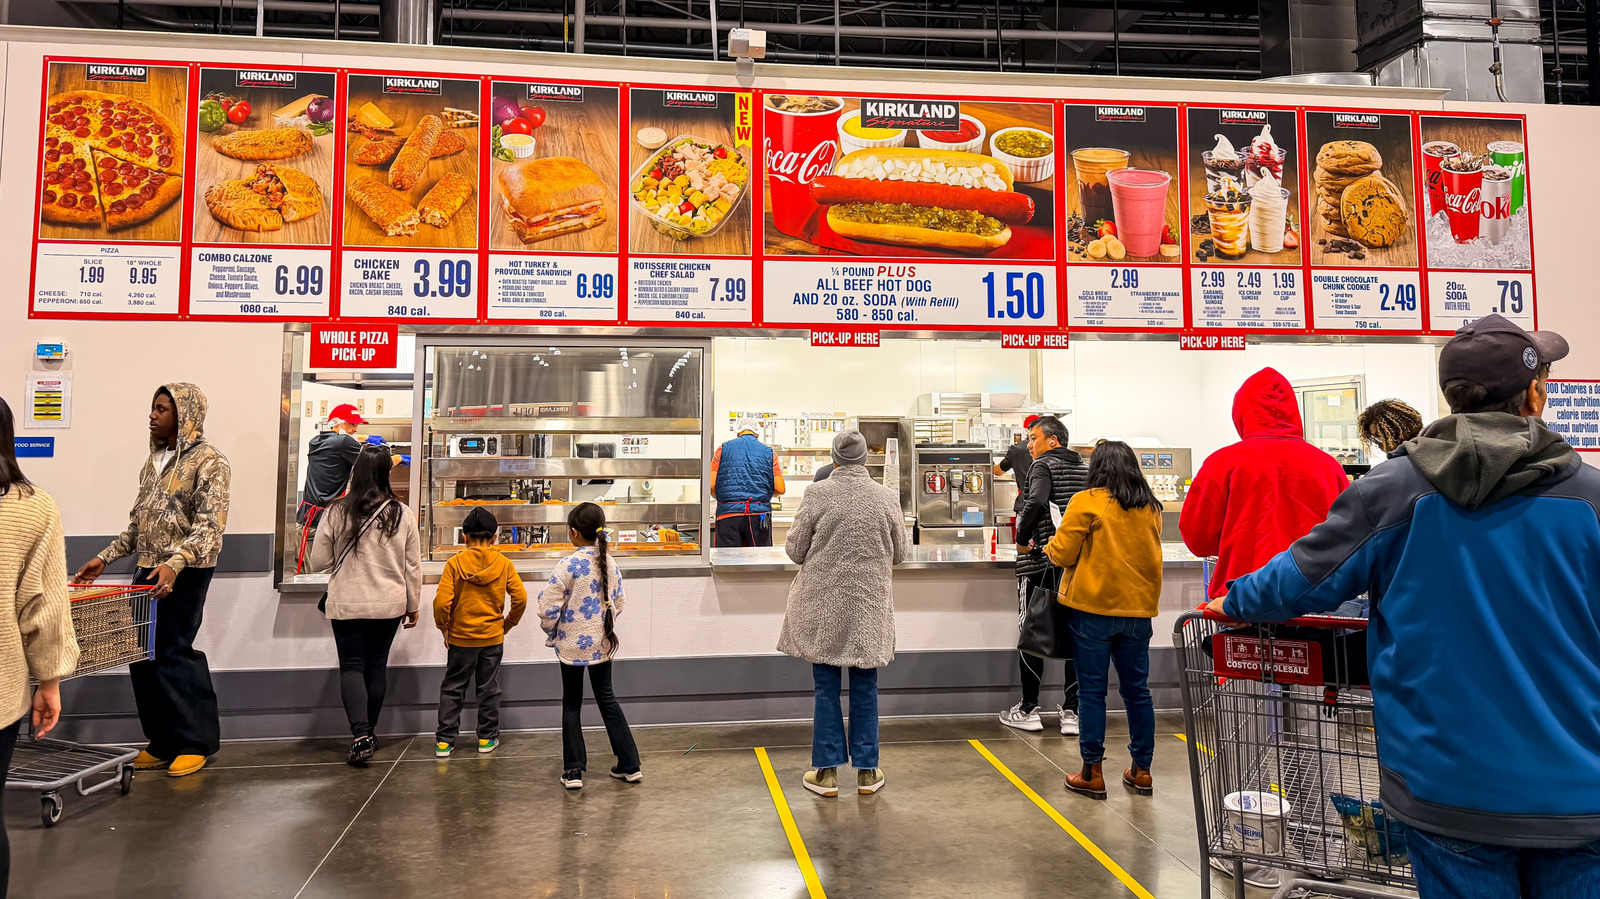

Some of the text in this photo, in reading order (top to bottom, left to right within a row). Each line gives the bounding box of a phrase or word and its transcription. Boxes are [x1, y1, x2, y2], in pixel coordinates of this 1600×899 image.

[89, 65, 146, 76] KIRKLAND
[240, 71, 294, 82] KIRKLAND
[386, 78, 440, 88] KIRKLAND
[530, 85, 581, 95] KIRKLAND
[666, 92, 715, 101] KIRKLAND
[866, 102, 956, 118] KIRKLAND
[1098, 107, 1144, 116] KIRKLAND
[1222, 110, 1266, 119] KIRKLAND
[737, 96, 751, 140] NEW
[866, 116, 956, 129] Signature
[1336, 114, 1379, 123] KIRKLAND
[198, 253, 273, 263] COMBO CALZONE
[236, 265, 257, 274] Sausage,
[354, 258, 400, 270] CHICKEN
[508, 260, 523, 268] HOT
[524, 260, 551, 268] TURKEY
[633, 262, 711, 271] ROTISSERIE CHICKEN
[79, 266, 105, 283] 1.99
[129, 267, 157, 285] 9.95
[362, 270, 391, 281] BAKE
[494, 268, 535, 276] PROVOLONE
[650, 270, 695, 279] CHEF SALAD
[842, 267, 875, 277] POUND
[877, 266, 917, 278] PLUS
[244, 274, 259, 282] Sauce,
[275, 265, 323, 296] 6.99
[413, 259, 472, 298] 3.99
[1110, 268, 1139, 289] 2.99
[1200, 271, 1225, 288] 2.99
[1237, 271, 1261, 288] 2.49
[1272, 272, 1295, 289] 1.99
[1313, 275, 1339, 283] DOUBLE
[576, 273, 614, 299] 6.99
[709, 277, 746, 302] 7.99
[816, 278, 932, 292] ALL BEEF HOT DOG
[982, 271, 1045, 319] 1.50
[1379, 283, 1416, 311] 2.49
[1445, 291, 1468, 301] SODA
[1492, 280, 1523, 314] .79
[38, 297, 79, 305] PEPPERONI:
[792, 293, 960, 310] AND 20 oz. SODA (With Refill)
[1444, 301, 1471, 311] WITH REFILL
[239, 304, 279, 314] 1080 cal.
[387, 305, 431, 316] 840 cal.
[553, 310, 567, 318] cal.
[675, 310, 706, 319] 840 cal.
[836, 308, 918, 322] 580 850 cal.
[1354, 320, 1381, 329] 750 cal.
[320, 331, 389, 345] WHOLE PIZZA
[812, 331, 879, 345] PICK-UP HERE
[1002, 334, 1068, 347] PICK-UP HERE
[1180, 336, 1245, 348] PICK-UP HERE
[331, 347, 376, 361] PICK-UP
[1560, 382, 1593, 394] Calories a
[1548, 396, 1572, 408] general
[1556, 409, 1599, 420] calorie needs
[1571, 422, 1599, 433] nutrition
[1581, 437, 1597, 447] upon
[1226, 660, 1258, 670] COSTCO
